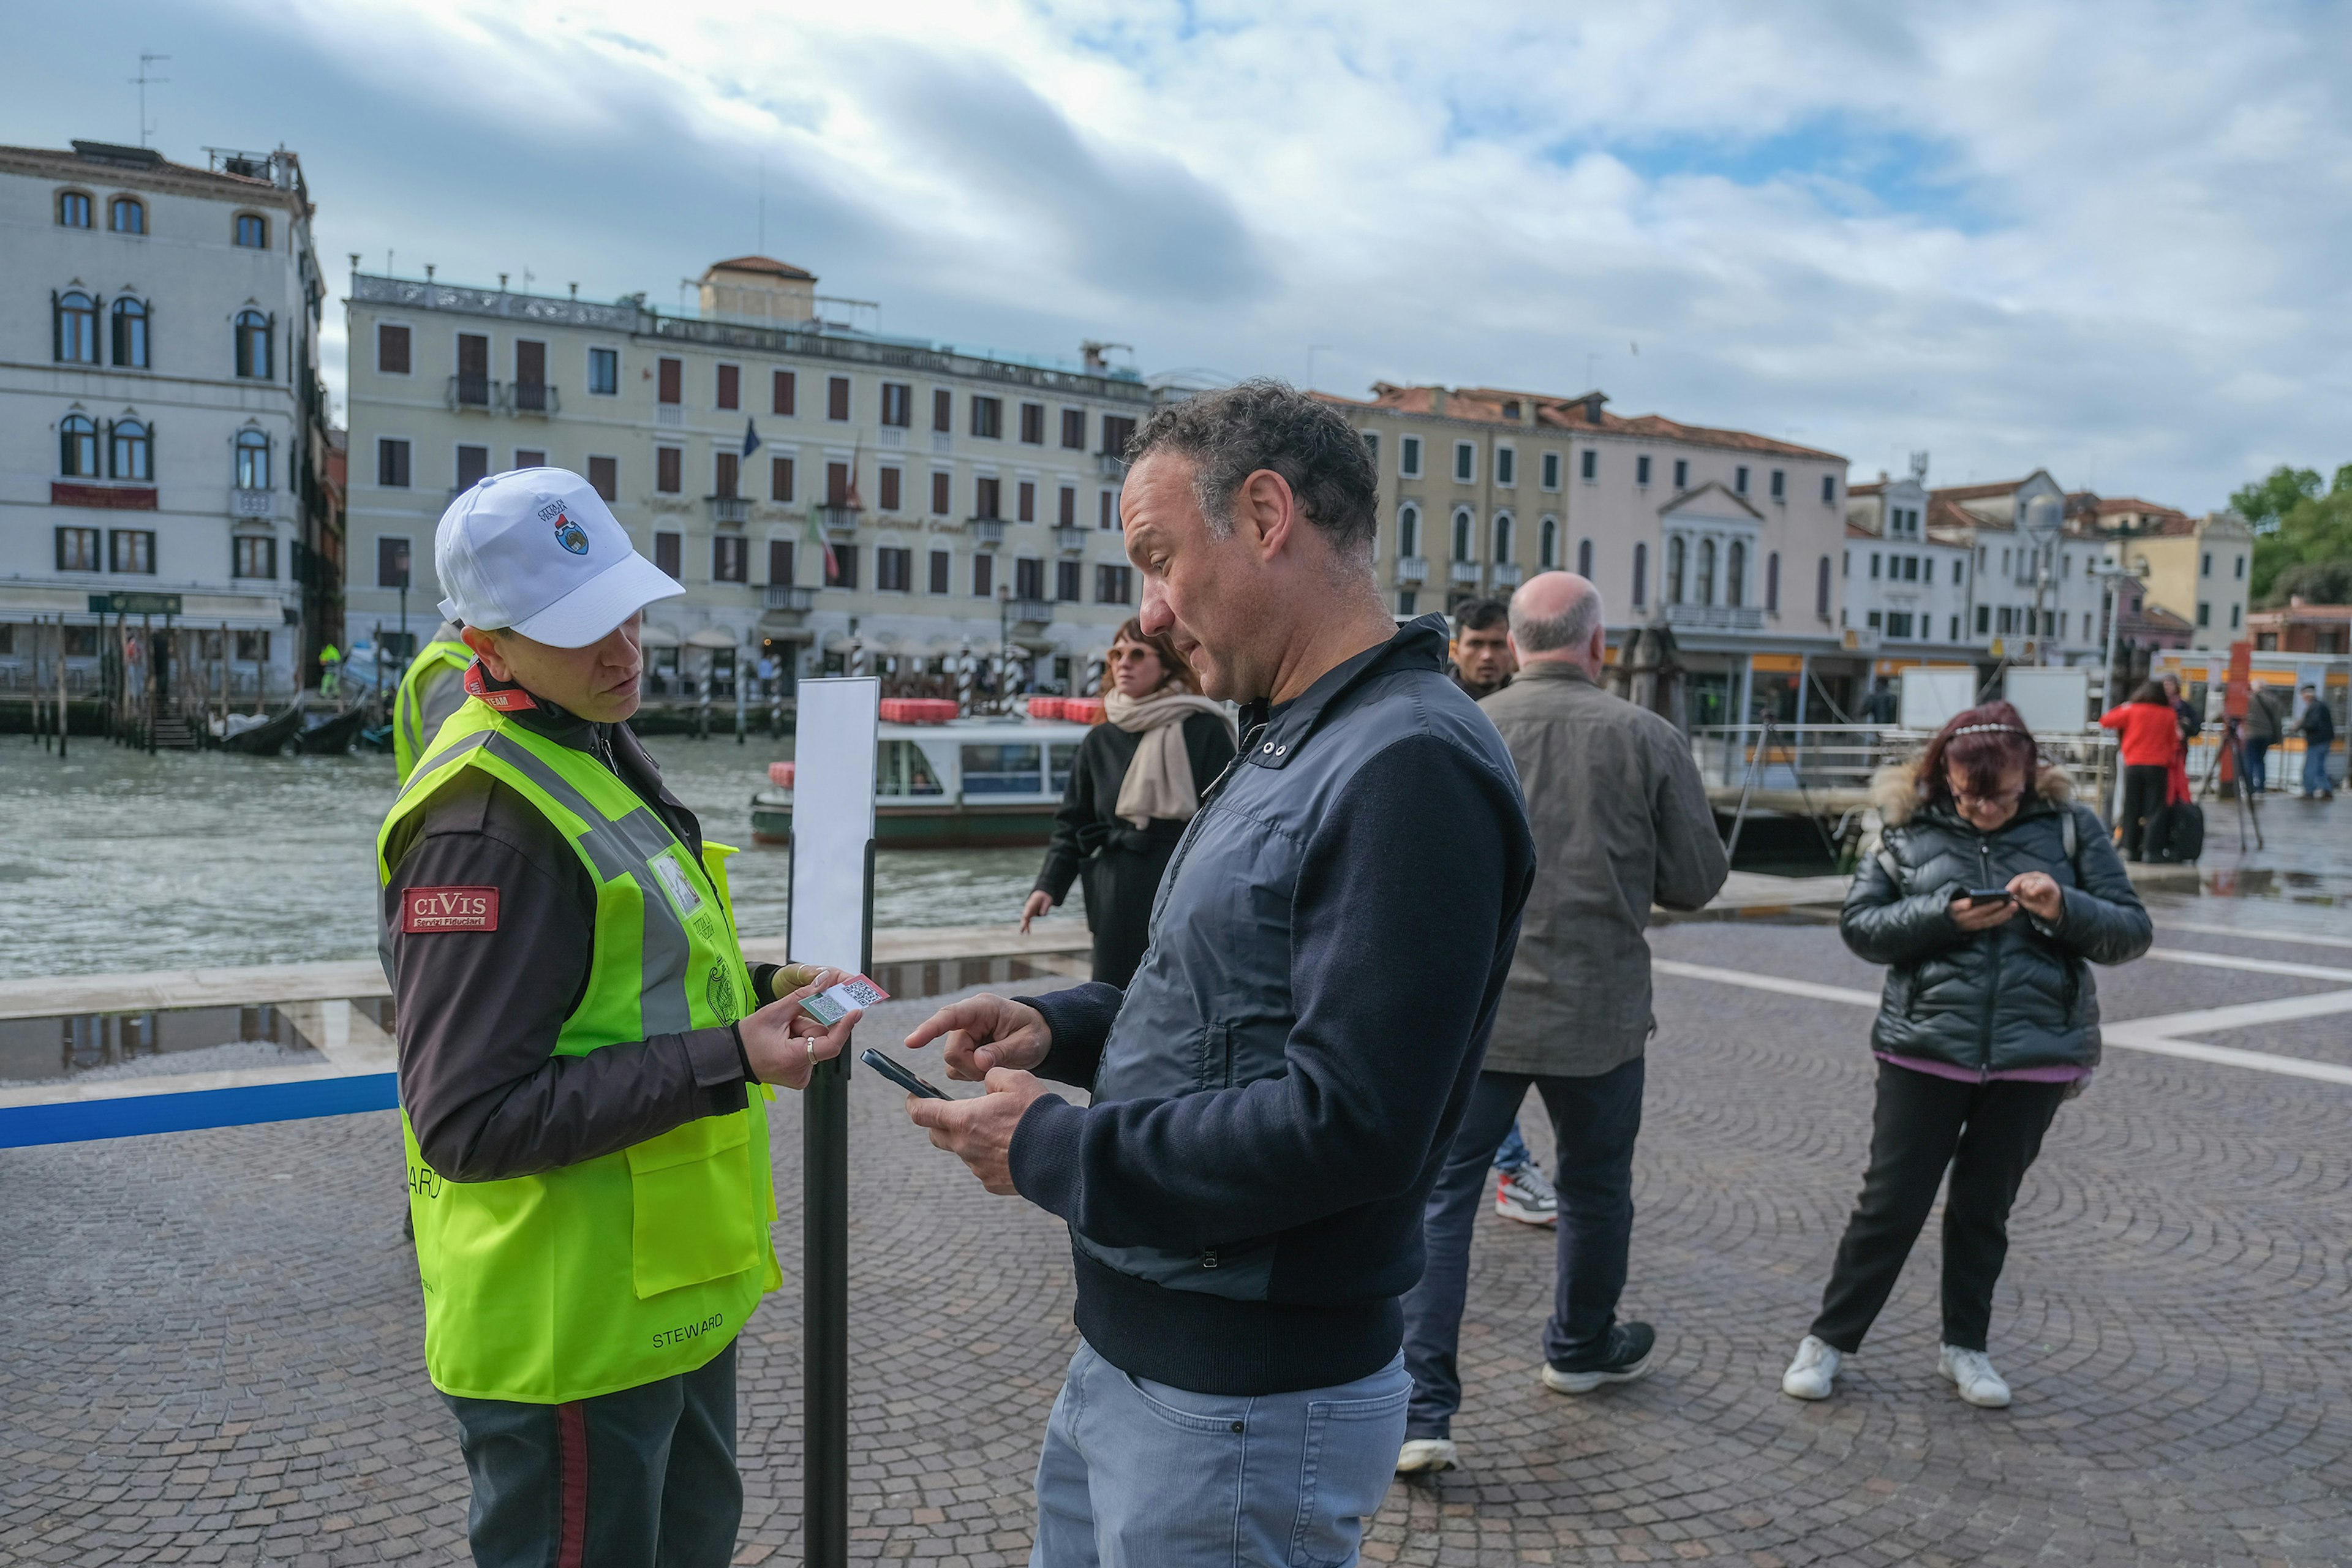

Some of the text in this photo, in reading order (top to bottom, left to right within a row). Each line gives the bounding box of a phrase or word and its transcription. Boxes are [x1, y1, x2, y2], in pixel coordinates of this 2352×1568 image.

[541, 505, 568, 521] VENEZIA
[485, 696, 509, 706] TEAM
[445, 918, 481, 926] Fiduciari
[652, 1313, 723, 1349] STEWARD
